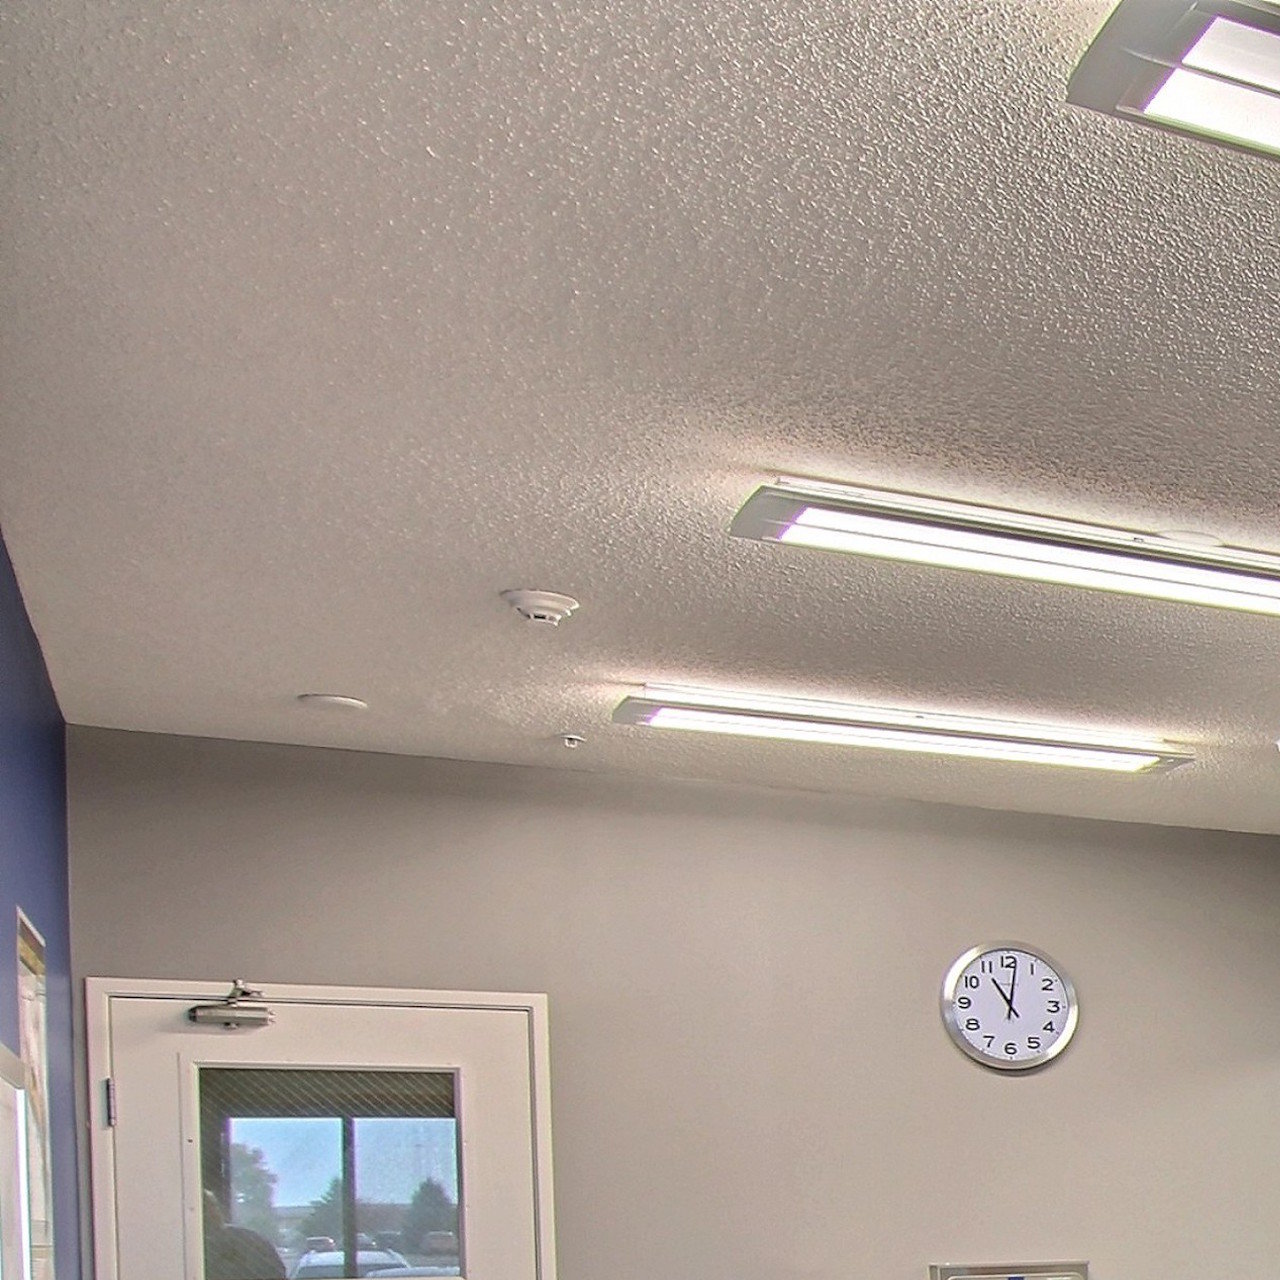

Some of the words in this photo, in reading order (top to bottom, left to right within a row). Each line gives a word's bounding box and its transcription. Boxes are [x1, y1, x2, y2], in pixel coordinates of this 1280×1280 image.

[980, 960, 993, 974] 11
[1000, 955, 1017, 968] 12
[1029, 962, 1035, 976] 1
[964, 975, 980, 989] 10
[1041, 978, 1054, 991] 2
[957, 996, 972, 1009] 9
[1047, 1000, 1060, 1013] 3
[966, 1018, 980, 1031] 8
[1042, 1021, 1055, 1033] 4
[983, 1035, 995, 1048] 7
[1027, 1037, 1041, 1049] 5
[1004, 1042, 1017, 1055] 6
